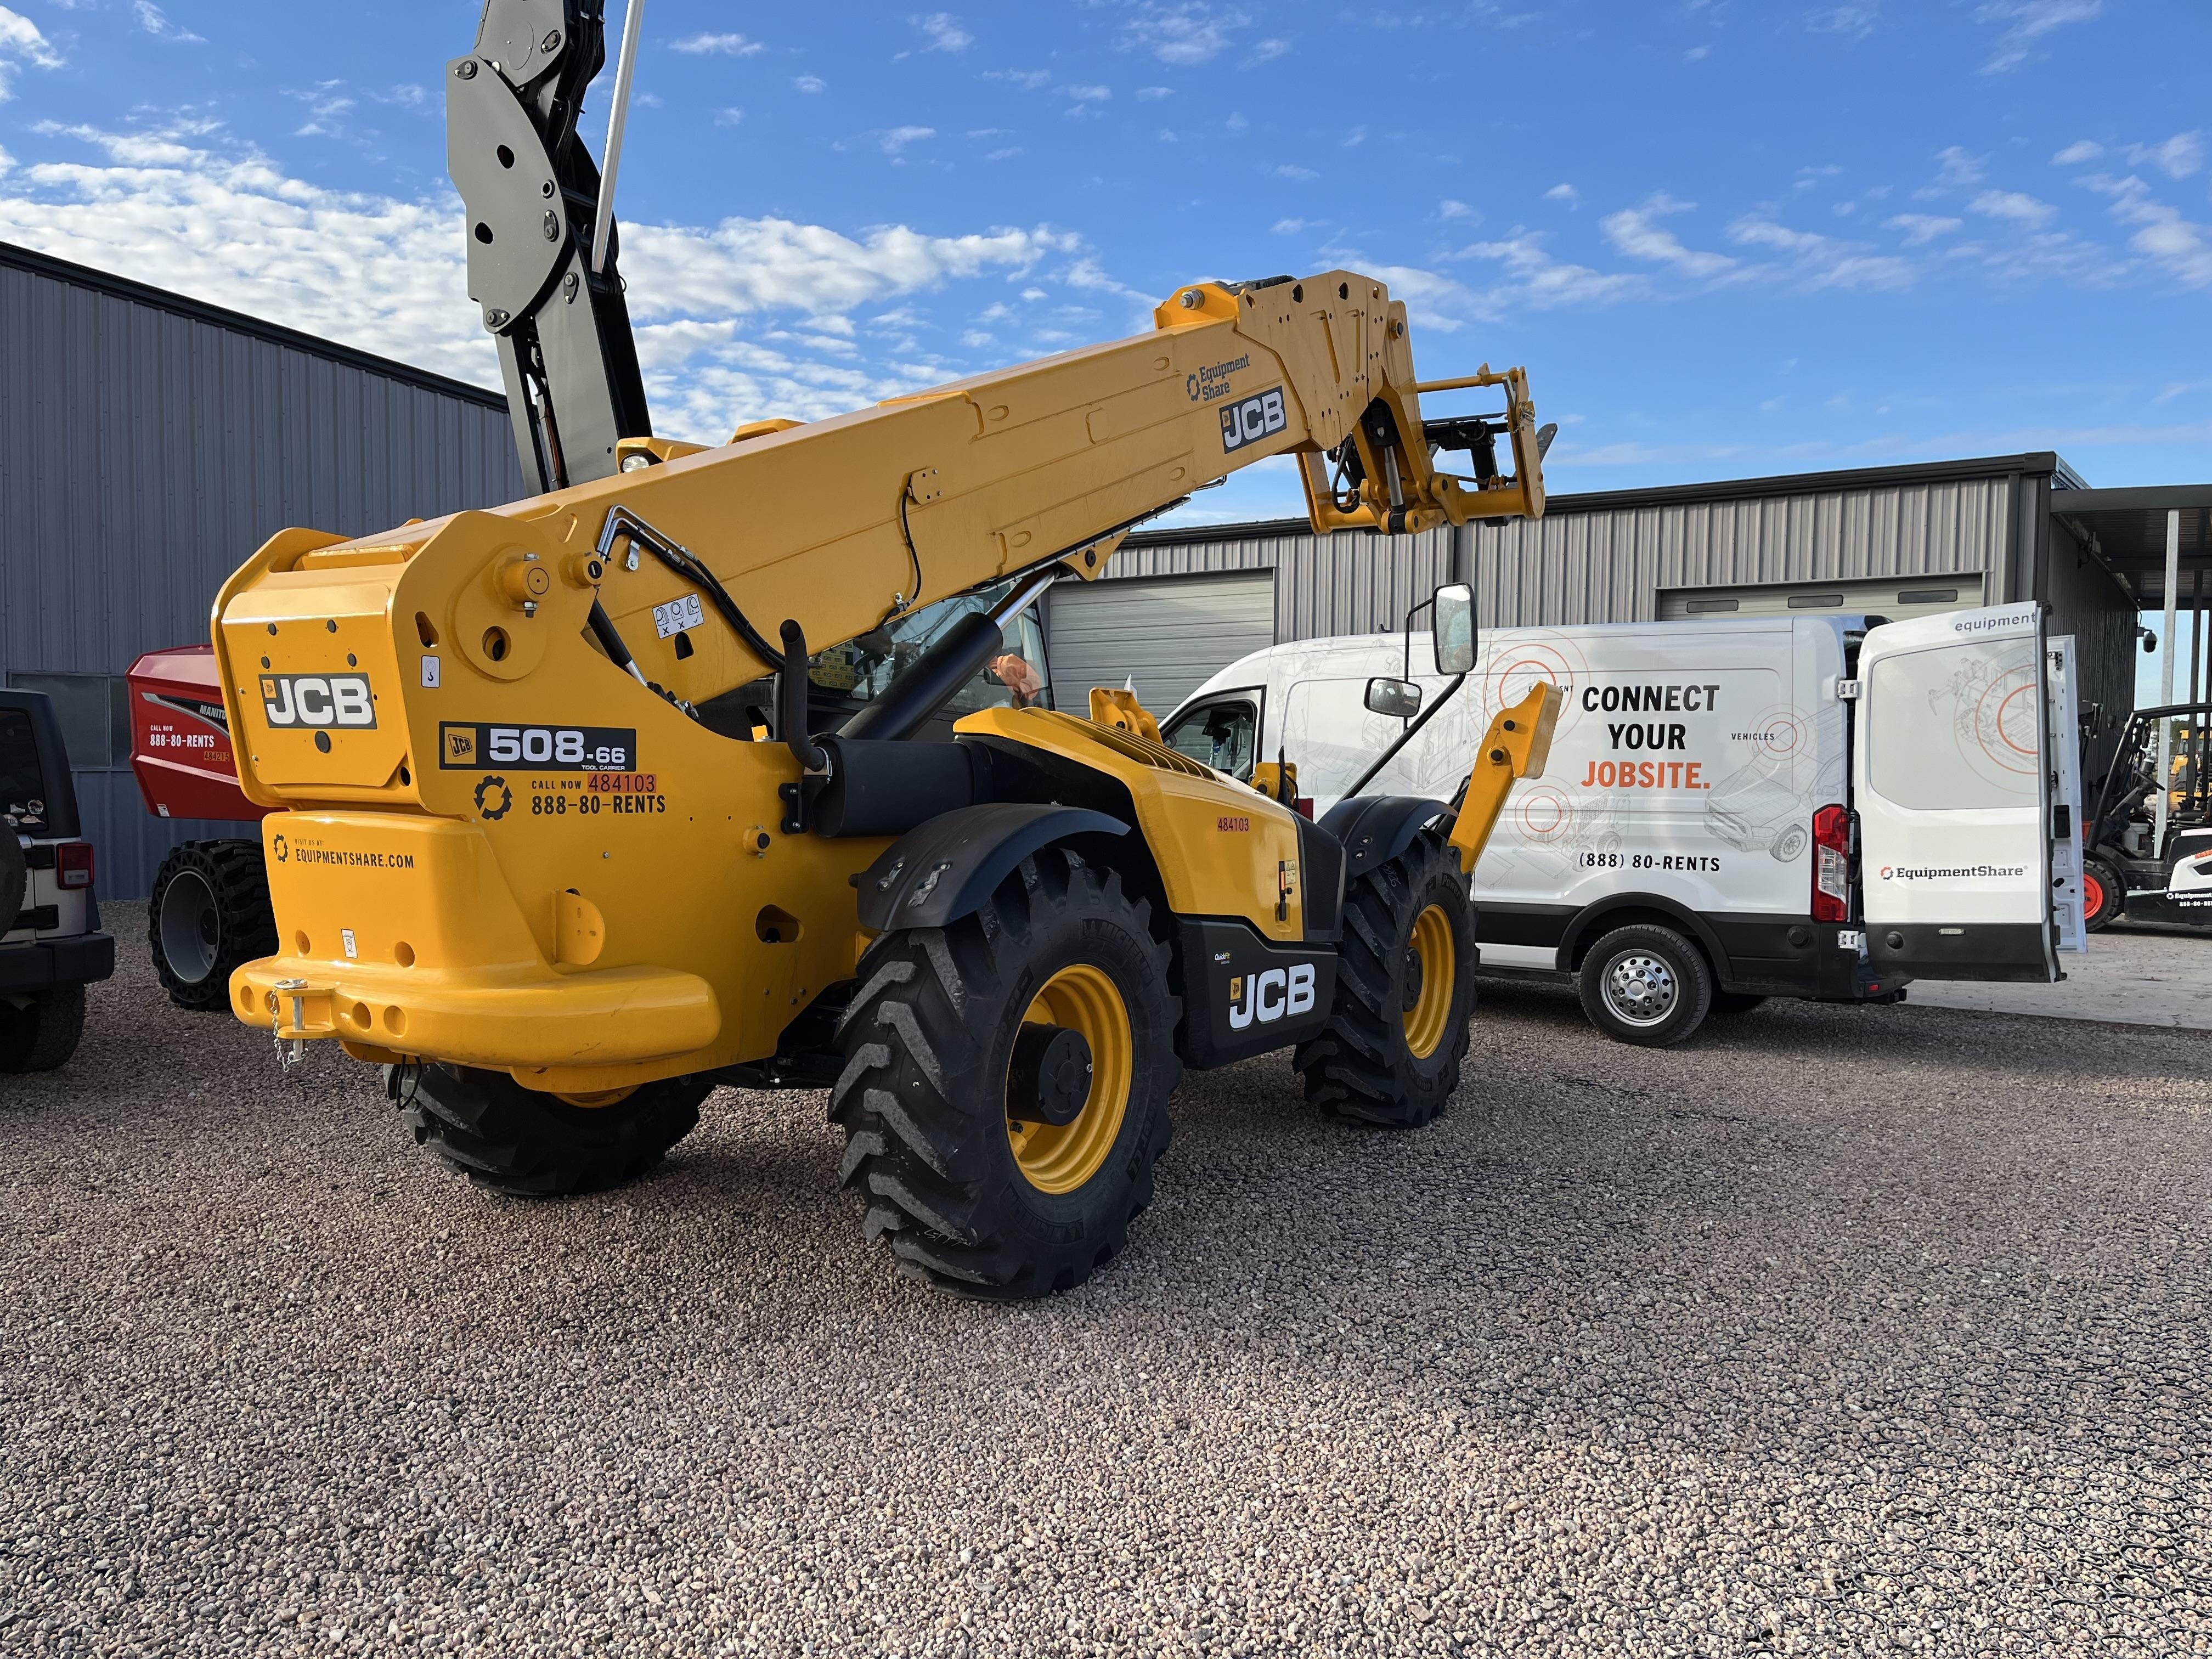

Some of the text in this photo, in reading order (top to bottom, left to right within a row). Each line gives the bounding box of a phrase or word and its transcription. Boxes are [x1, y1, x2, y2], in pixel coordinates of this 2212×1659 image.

[1199, 353, 1250, 383] Equipment
[1202, 382, 1230, 401] Share
[1224, 391, 1284, 448] JCB
[1955, 612, 2035, 631] equipment
[267, 678, 373, 724] JCB
[1582, 685, 1720, 712] CONNECT
[150, 734, 215, 748] 888-80-RENTS
[452, 736, 471, 755] JCB
[1607, 724, 1686, 749] YOUR
[204, 752, 229, 761] 484215
[589, 774, 654, 792] 484103
[1581, 761, 1710, 789] JOBSITE.
[532, 781, 582, 789] CALL NOW
[532, 795, 665, 815] 888-80-RENTS
[1217, 817, 1249, 831] 484103
[296, 849, 414, 868] EQUIPMENTSHARE.COM
[1579, 853, 1720, 871] (888) 80-RENTS
[1897, 866, 2023, 879] EquipmentShare
[1229, 963, 1315, 1029] JCB
